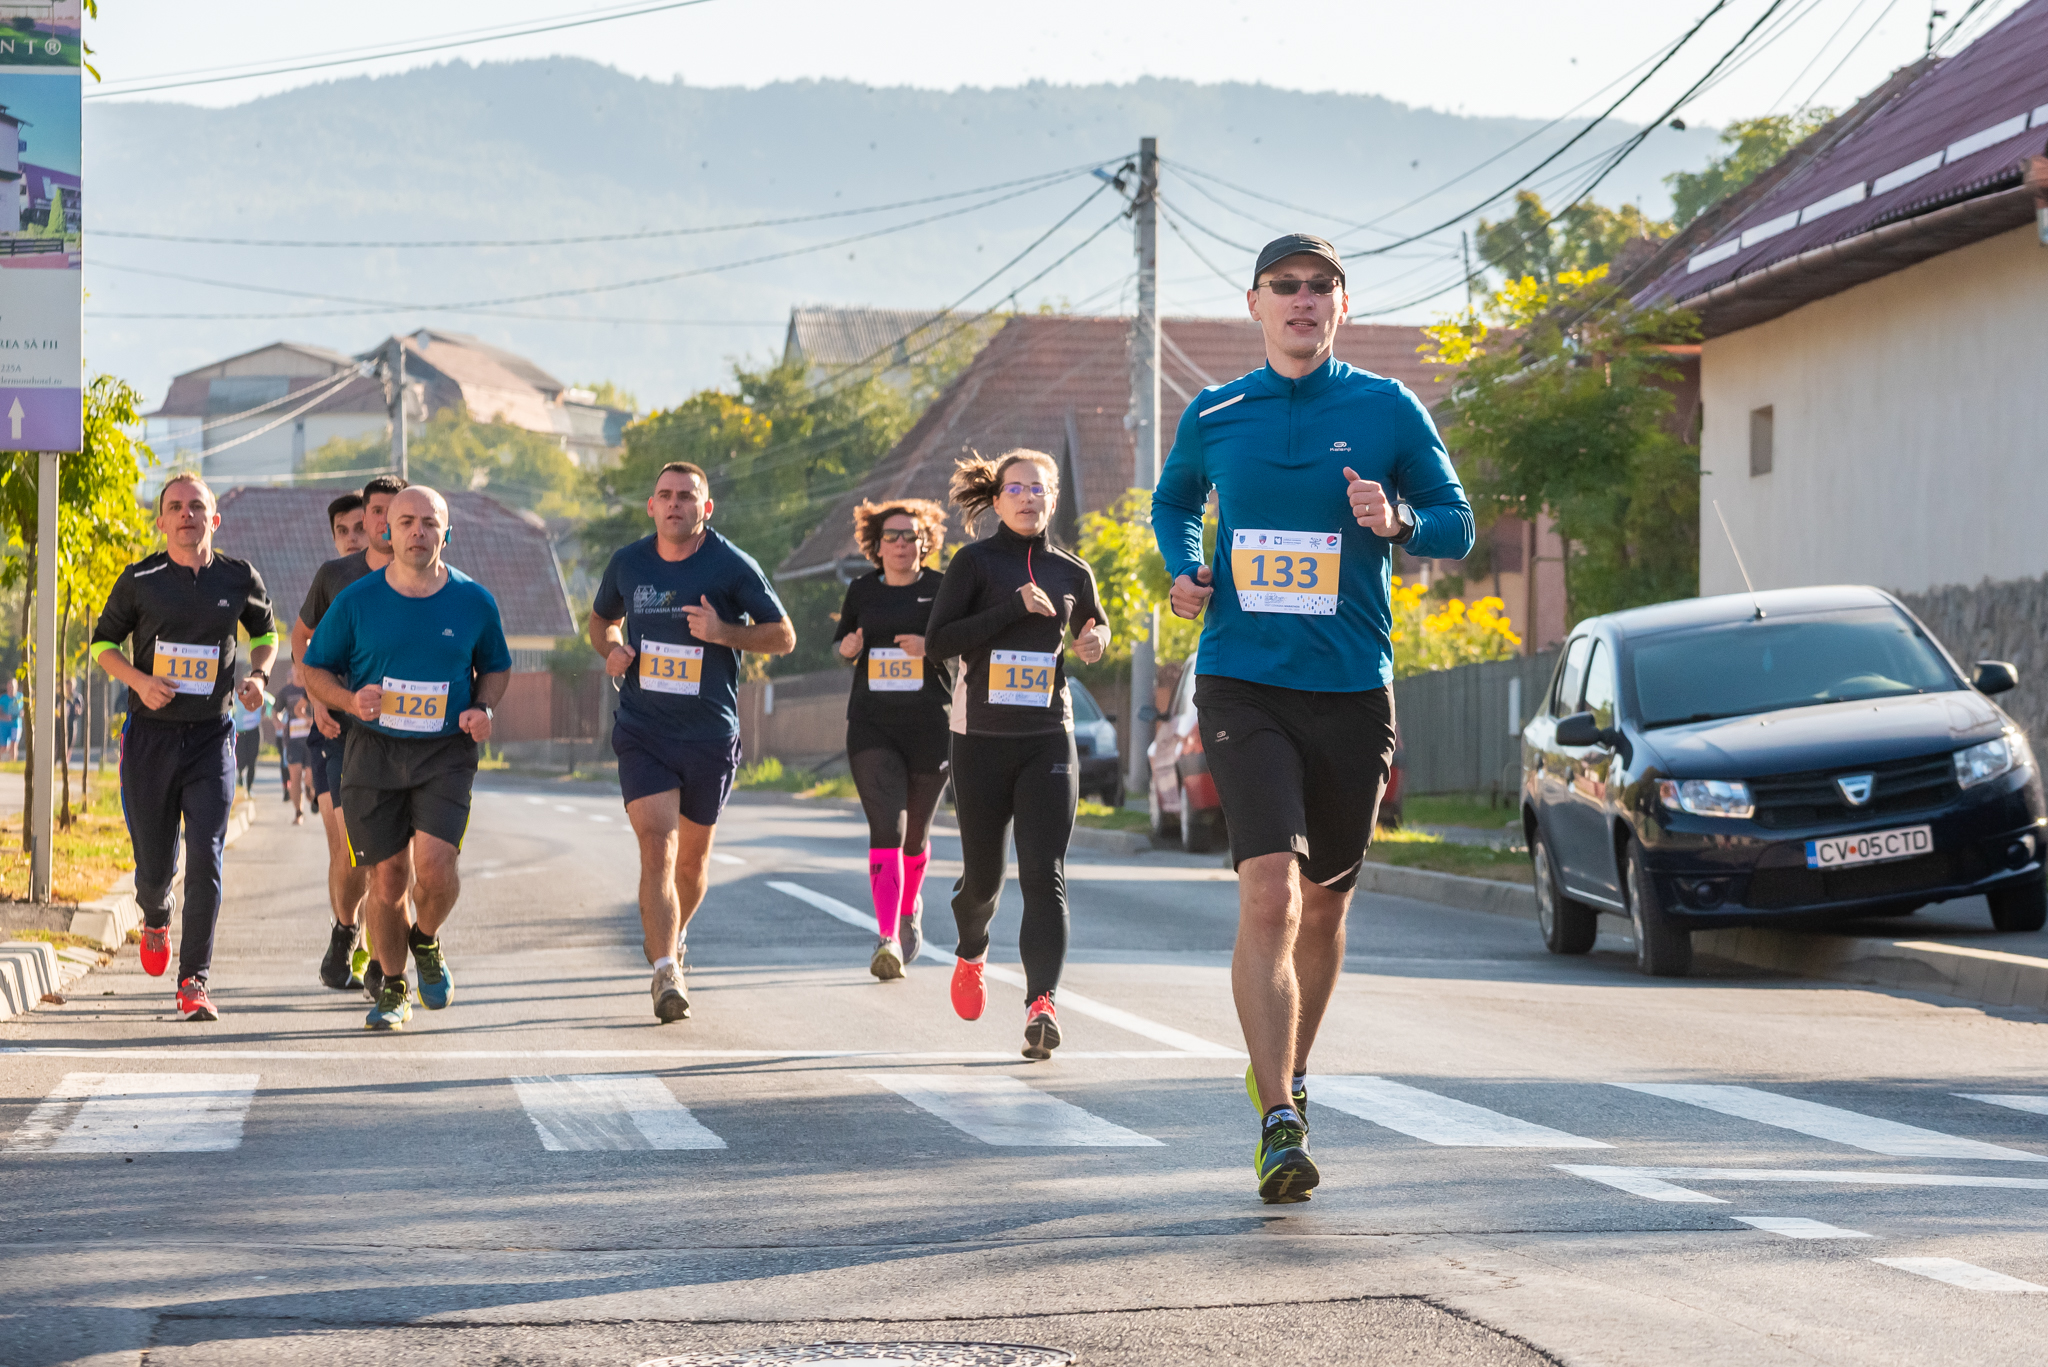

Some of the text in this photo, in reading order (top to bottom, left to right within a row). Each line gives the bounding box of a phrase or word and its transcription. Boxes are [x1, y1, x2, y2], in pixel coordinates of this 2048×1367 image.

[1250, 554, 1319, 589] 133
[167, 658, 208, 680] 118
[650, 657, 688, 680] 131
[879, 661, 912, 678] 165
[1006, 667, 1048, 690] 154
[395, 695, 437, 717] 126
